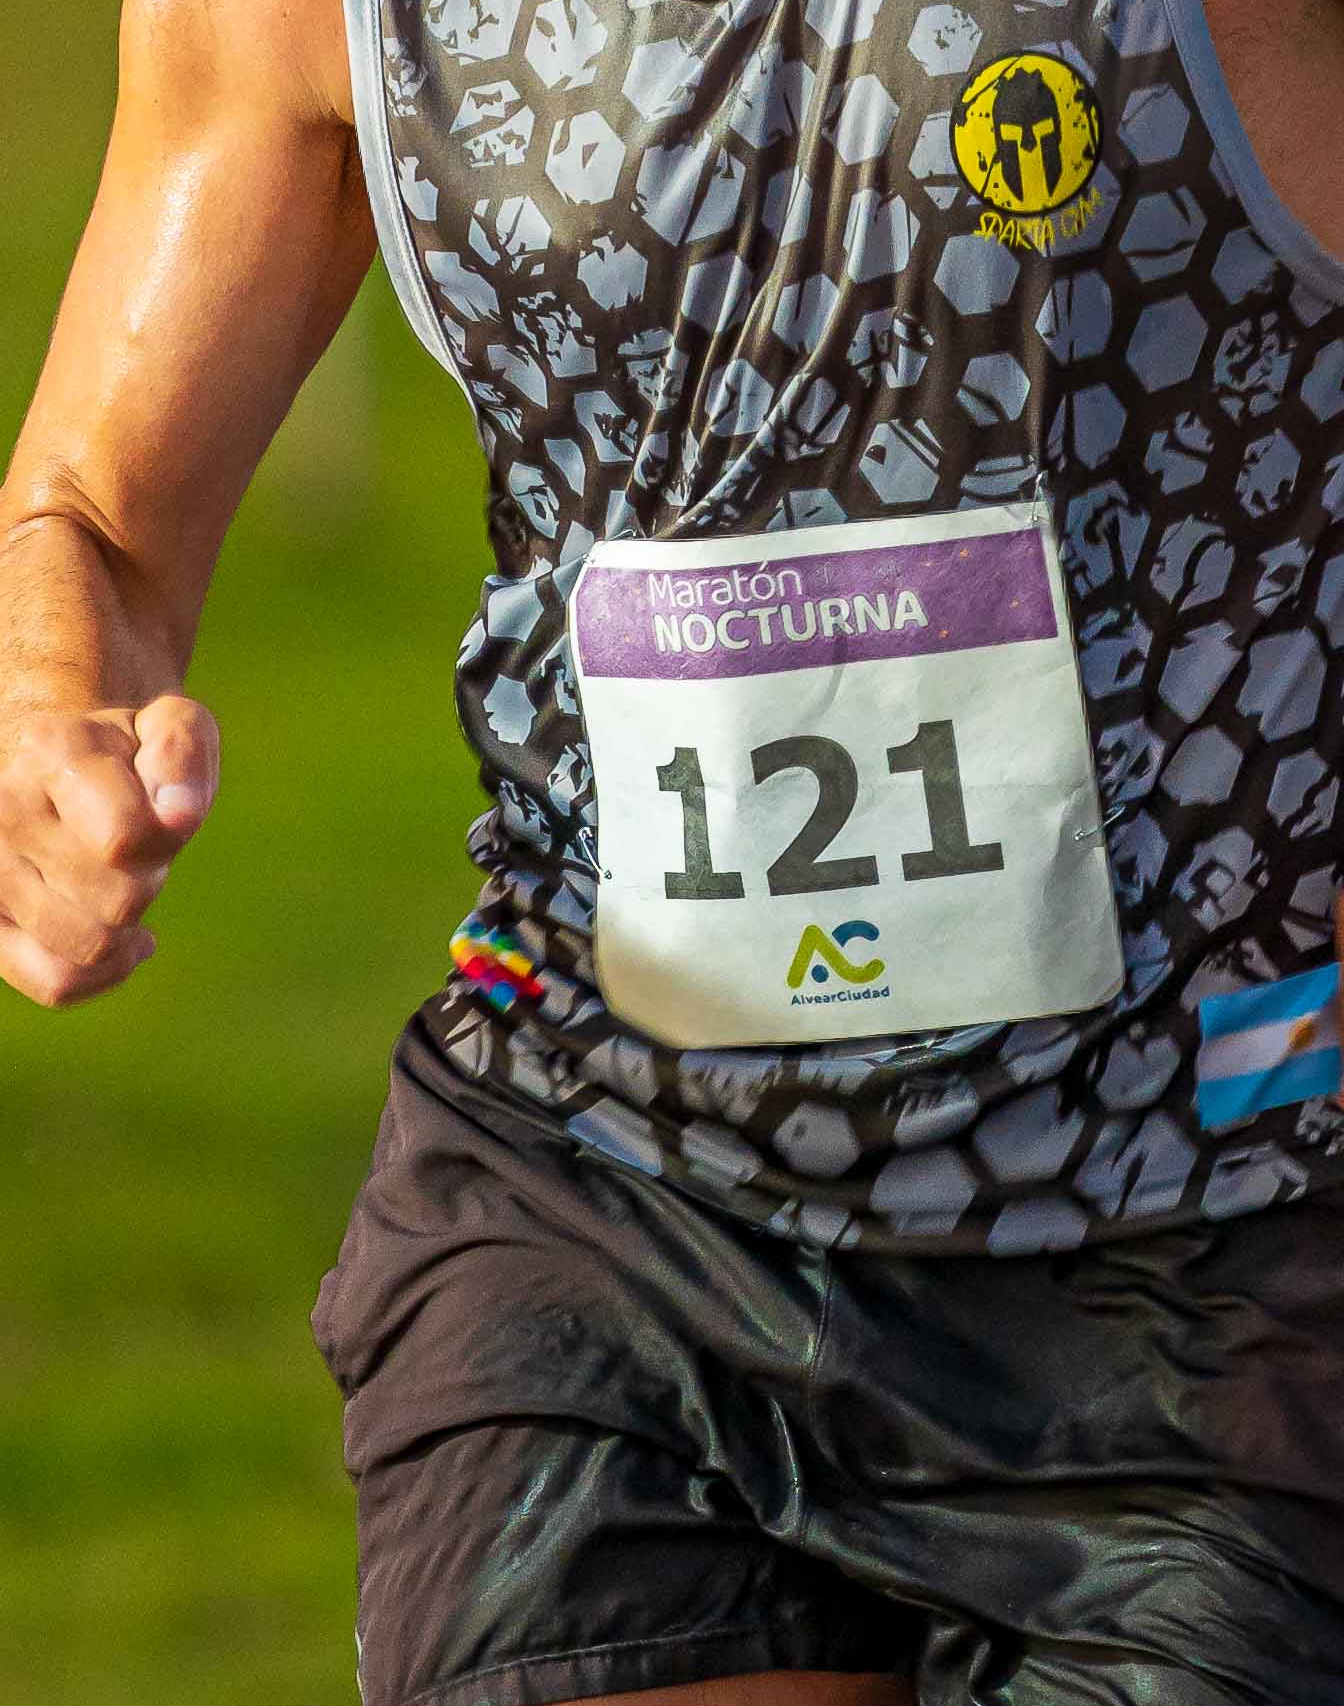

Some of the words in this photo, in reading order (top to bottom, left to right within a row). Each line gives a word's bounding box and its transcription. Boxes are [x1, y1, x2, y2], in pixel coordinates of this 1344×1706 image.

[647, 561, 803, 607] Maratón
[651, 589, 929, 654] NOCTURNA
[655, 718, 1005, 900] 121
